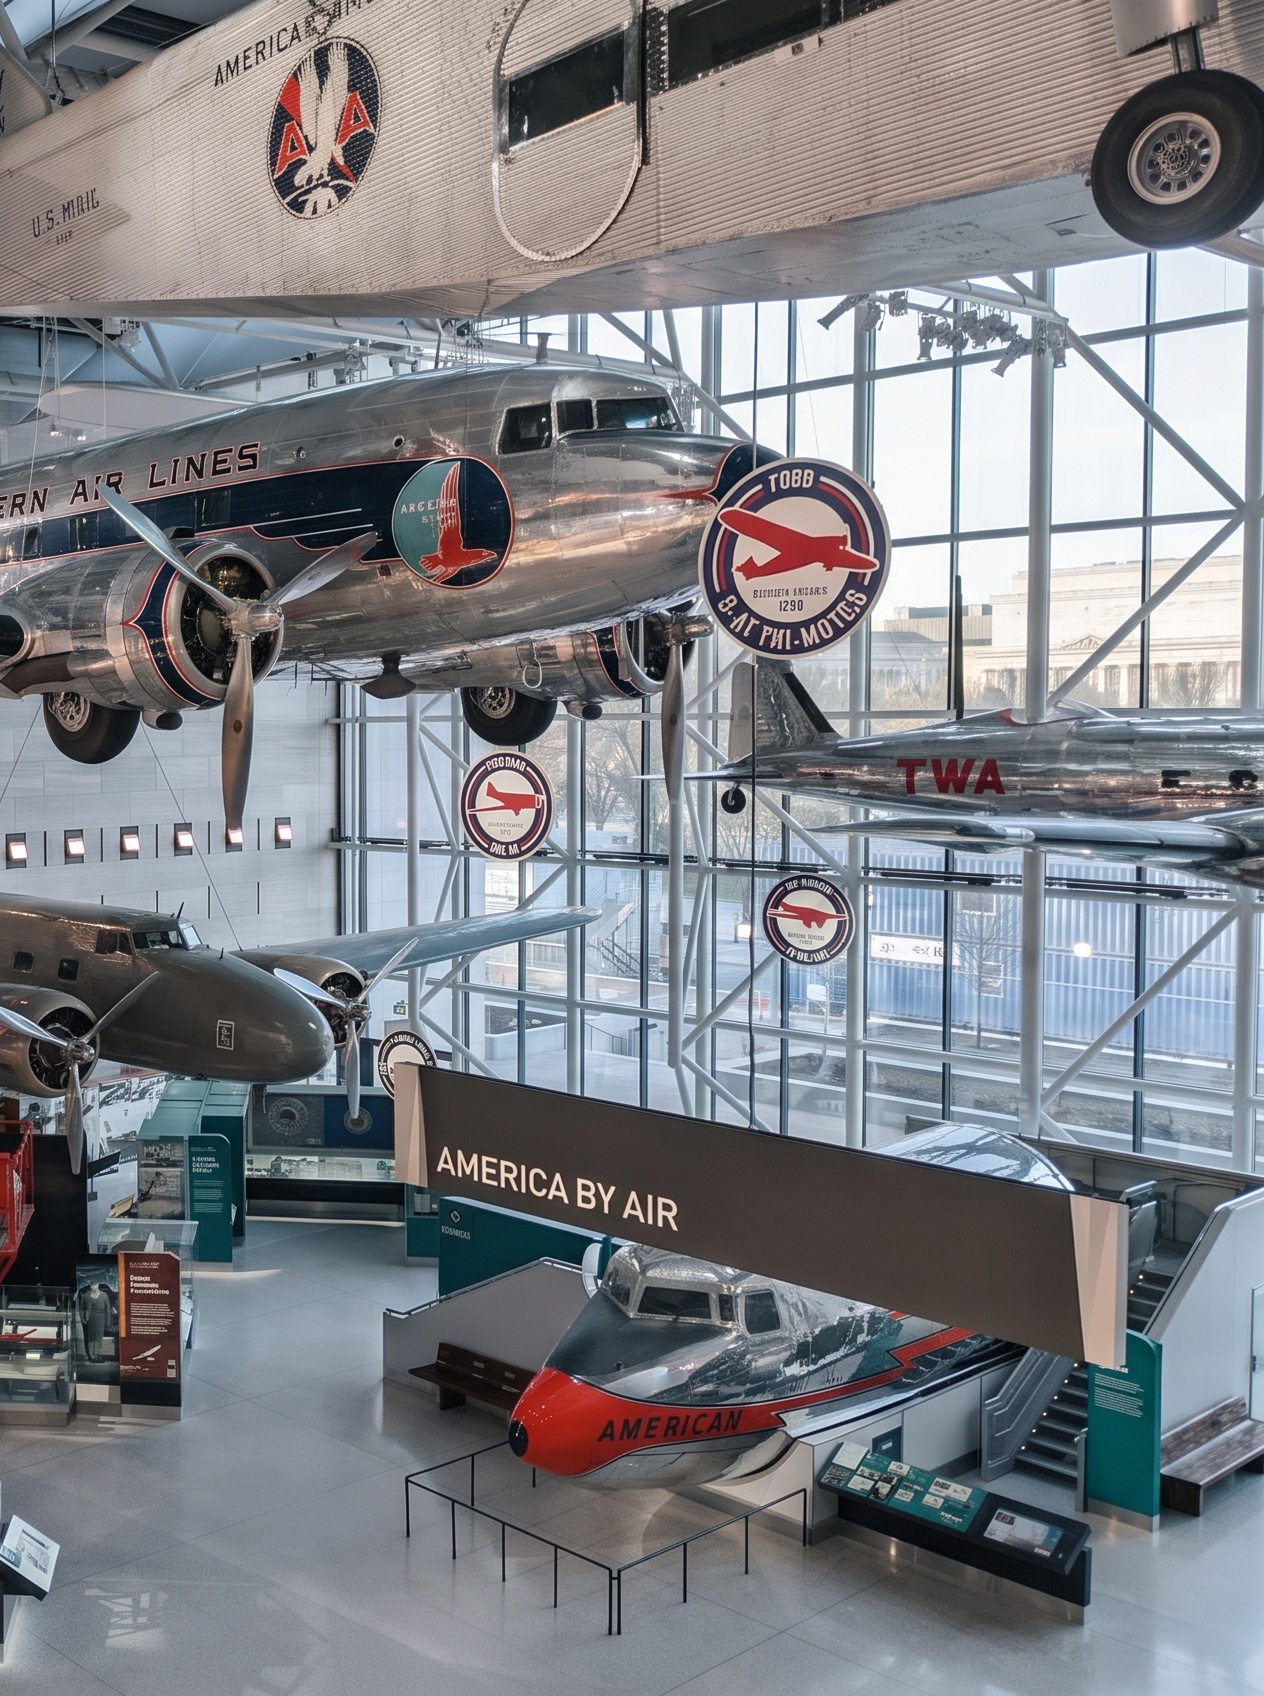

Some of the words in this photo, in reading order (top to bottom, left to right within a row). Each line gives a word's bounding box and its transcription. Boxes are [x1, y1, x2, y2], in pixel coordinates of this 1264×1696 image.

[69, 471, 124, 506] AIR
[147, 442, 261, 490] LINES
[896, 758, 1006, 795] TWA
[436, 1146, 569, 1204] AMERICA
[576, 1177, 616, 1214] BY
[622, 1190, 679, 1232] AIR
[597, 1410, 744, 1442] AMERICAN
